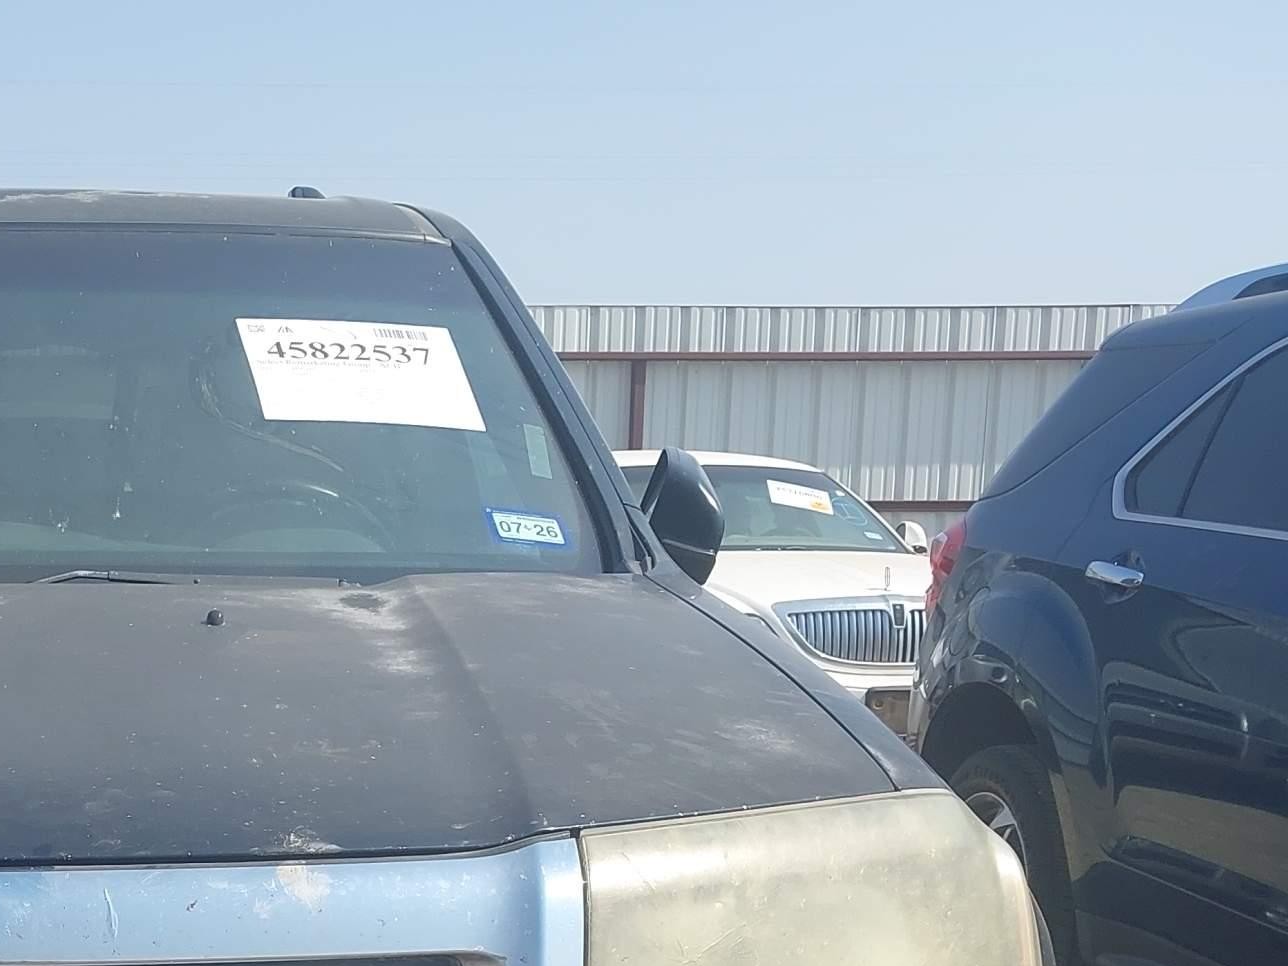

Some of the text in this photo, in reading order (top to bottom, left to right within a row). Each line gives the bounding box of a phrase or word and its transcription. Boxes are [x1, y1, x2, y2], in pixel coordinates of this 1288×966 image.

[266, 340, 430, 366] 45822537
[498, 520, 559, 538] 07 26
